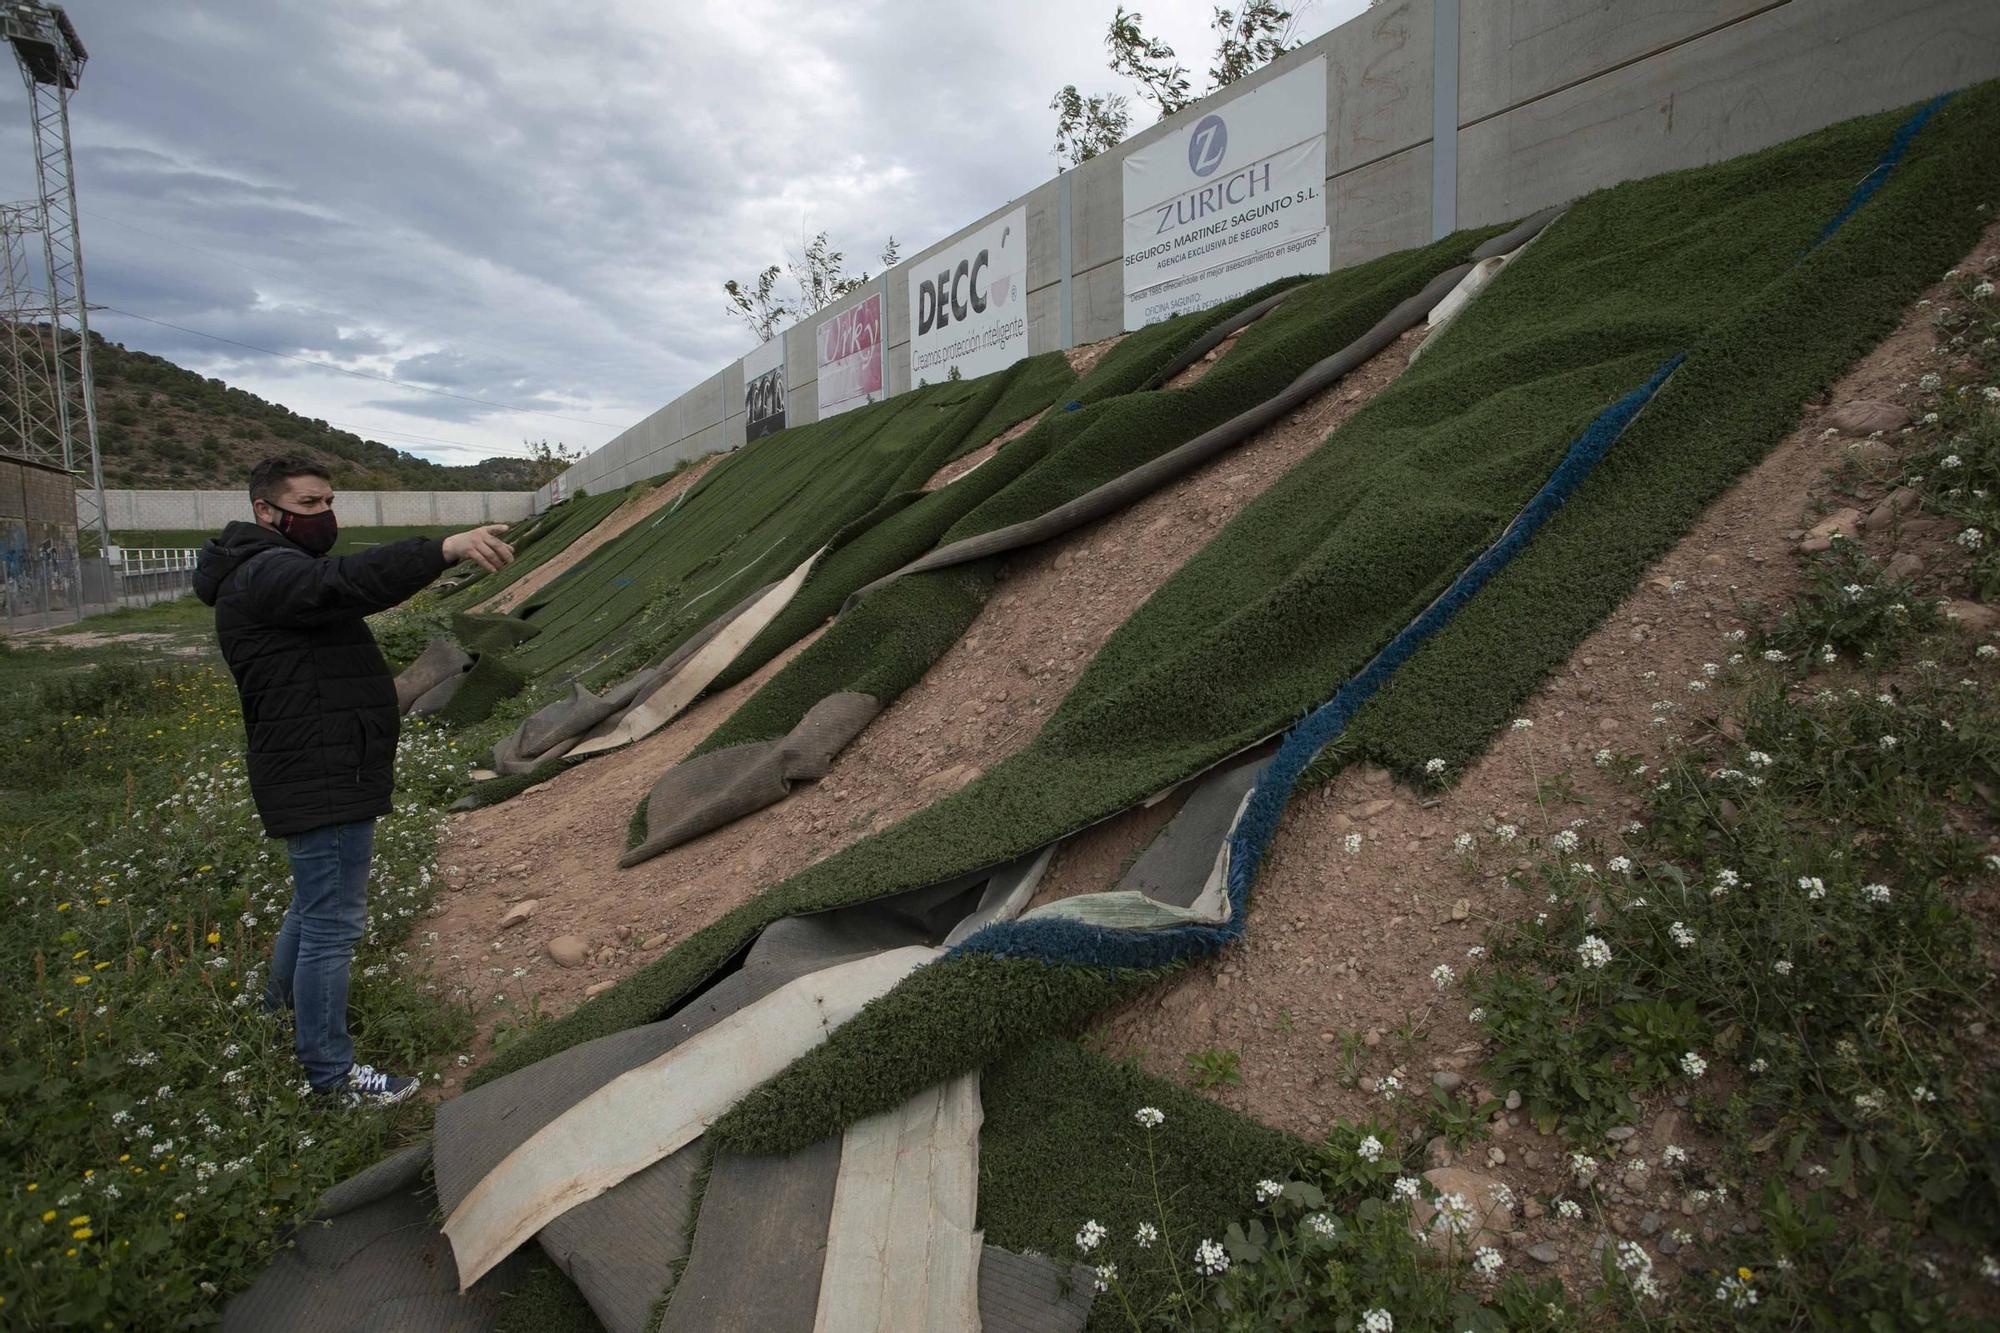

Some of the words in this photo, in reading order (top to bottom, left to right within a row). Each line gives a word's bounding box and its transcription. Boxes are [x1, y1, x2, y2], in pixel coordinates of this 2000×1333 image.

[1156, 163, 1270, 235] ZURICH
[1125, 241, 1171, 267] SEGUROS
[1174, 219, 1228, 250] MARTINEZ
[1231, 196, 1293, 227] SAGUNTO
[1296, 187, 1319, 204] S.L.
[1157, 252, 1187, 270] AGENCIA
[1187, 237, 1227, 260] EXCLUSIVA
[1228, 234, 1239, 245] DE
[1240, 219, 1280, 241] SEGUROS
[1206, 266, 1225, 280] mejor
[1225, 250, 1275, 273] asesoramiento
[1275, 246, 1286, 257] en
[1145, 302, 1170, 317] OFICINA
[912, 346, 941, 372] Creamos
[942, 328, 981, 368] protección
[981, 316, 1024, 351] inteligente
